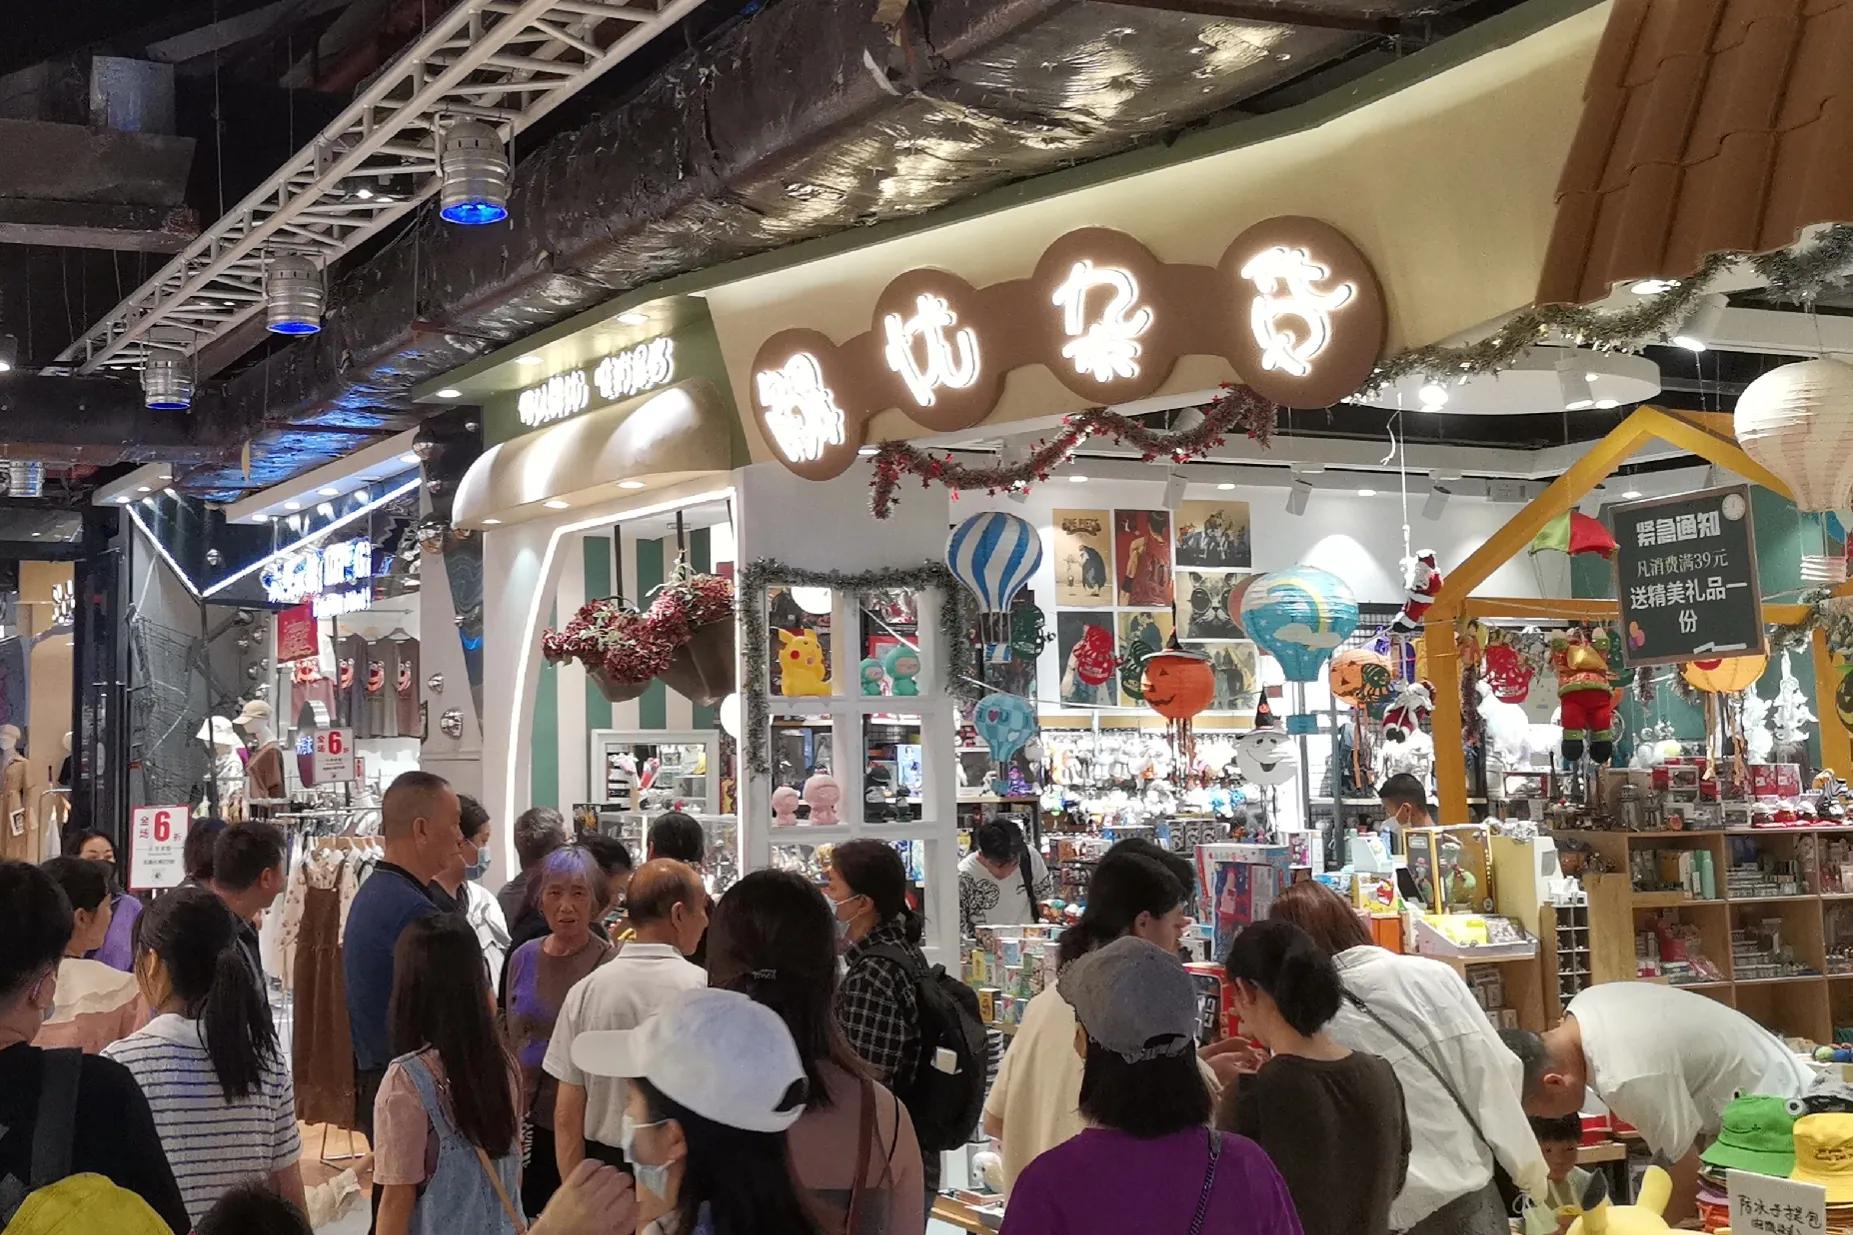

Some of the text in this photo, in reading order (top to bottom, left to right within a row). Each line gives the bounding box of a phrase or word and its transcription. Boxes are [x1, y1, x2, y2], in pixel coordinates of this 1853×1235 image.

[1636, 511, 1721, 547] 紧急通知
[1637, 549, 1729, 578] 凡消费满39元
[1630, 576, 1748, 610] 送精美礼品一
[1678, 609, 1698, 634] 份
[328, 731, 342, 755] 6
[154, 811, 171, 842] 6
